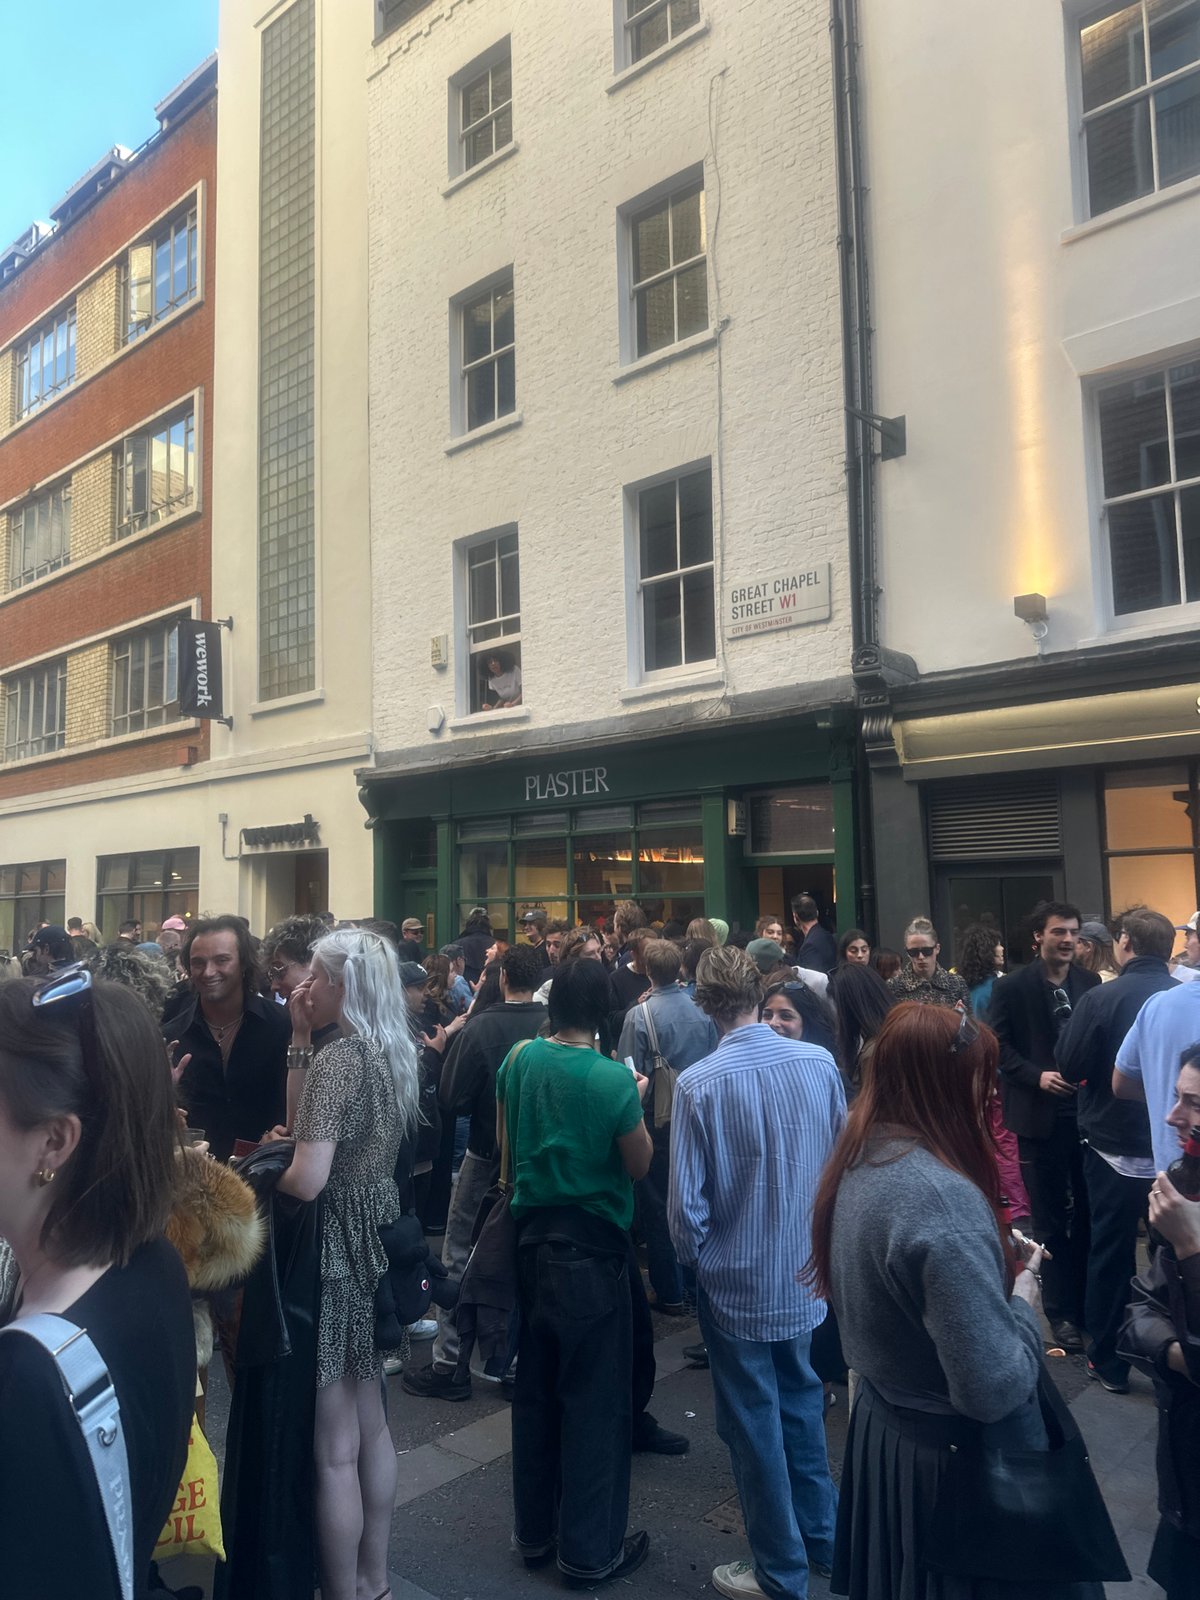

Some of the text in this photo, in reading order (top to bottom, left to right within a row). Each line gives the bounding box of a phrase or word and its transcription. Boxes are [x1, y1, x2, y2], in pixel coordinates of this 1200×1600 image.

[732, 571, 820, 603] GREAT CHAPEL
[732, 593, 797, 620] STREET W1
[745, 624, 752, 632] OF
[753, 616, 793, 630] WESTMINSTER
[195, 632, 212, 707] wework
[525, 766, 610, 801] PLASTER
